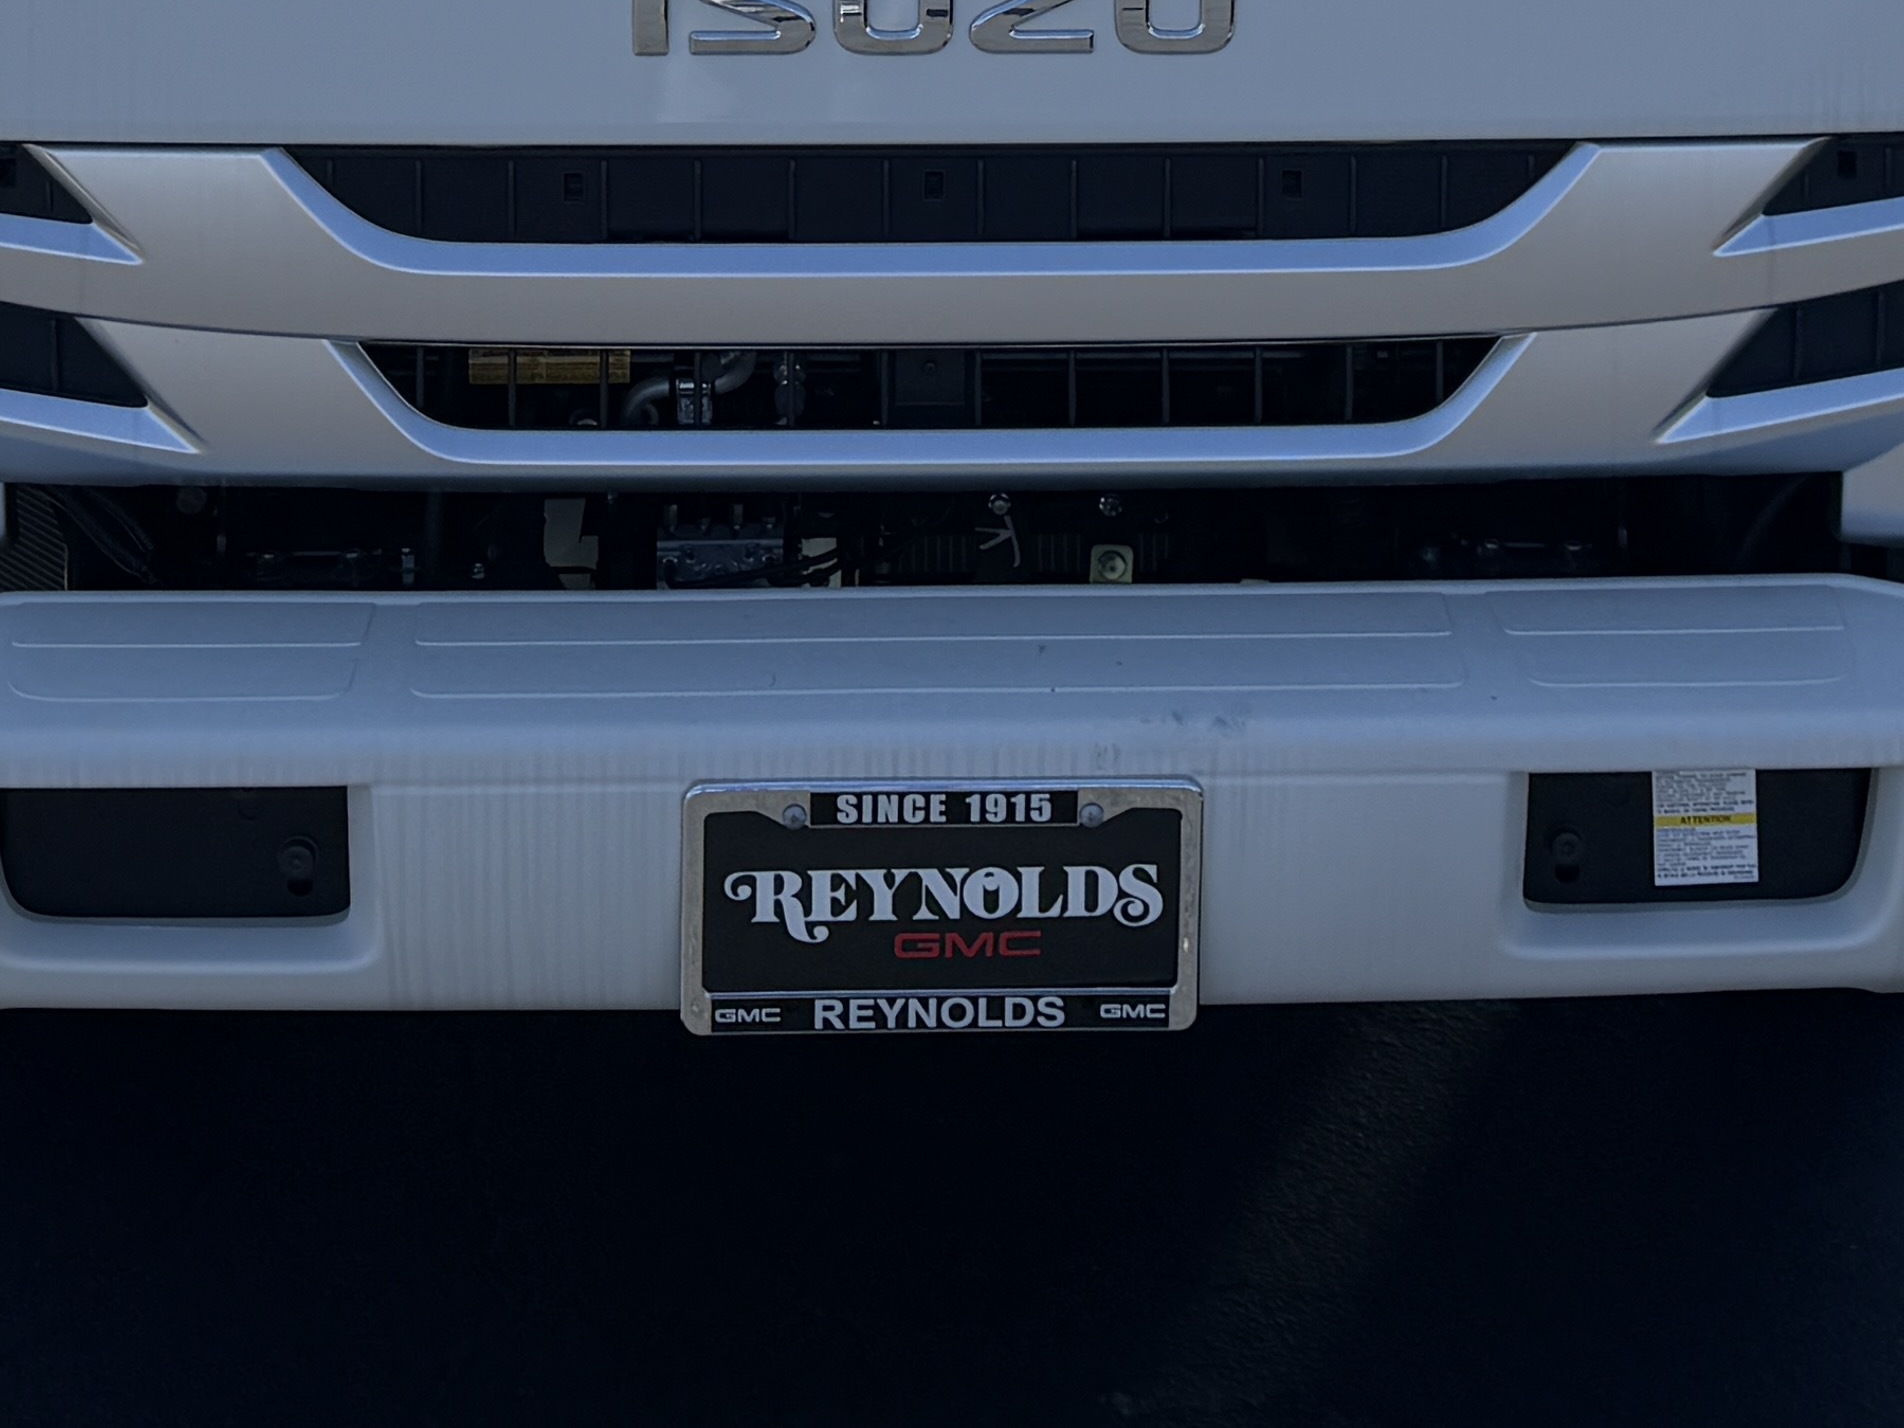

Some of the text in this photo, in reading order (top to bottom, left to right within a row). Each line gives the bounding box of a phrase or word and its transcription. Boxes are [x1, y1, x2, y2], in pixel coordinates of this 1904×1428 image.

[836, 793, 1053, 824] SINCE 1915
[723, 863, 1164, 944] REYNOLDS
[893, 929, 1042, 959] GMC
[714, 995, 1167, 1031] GMC REYNOLDS GMC
